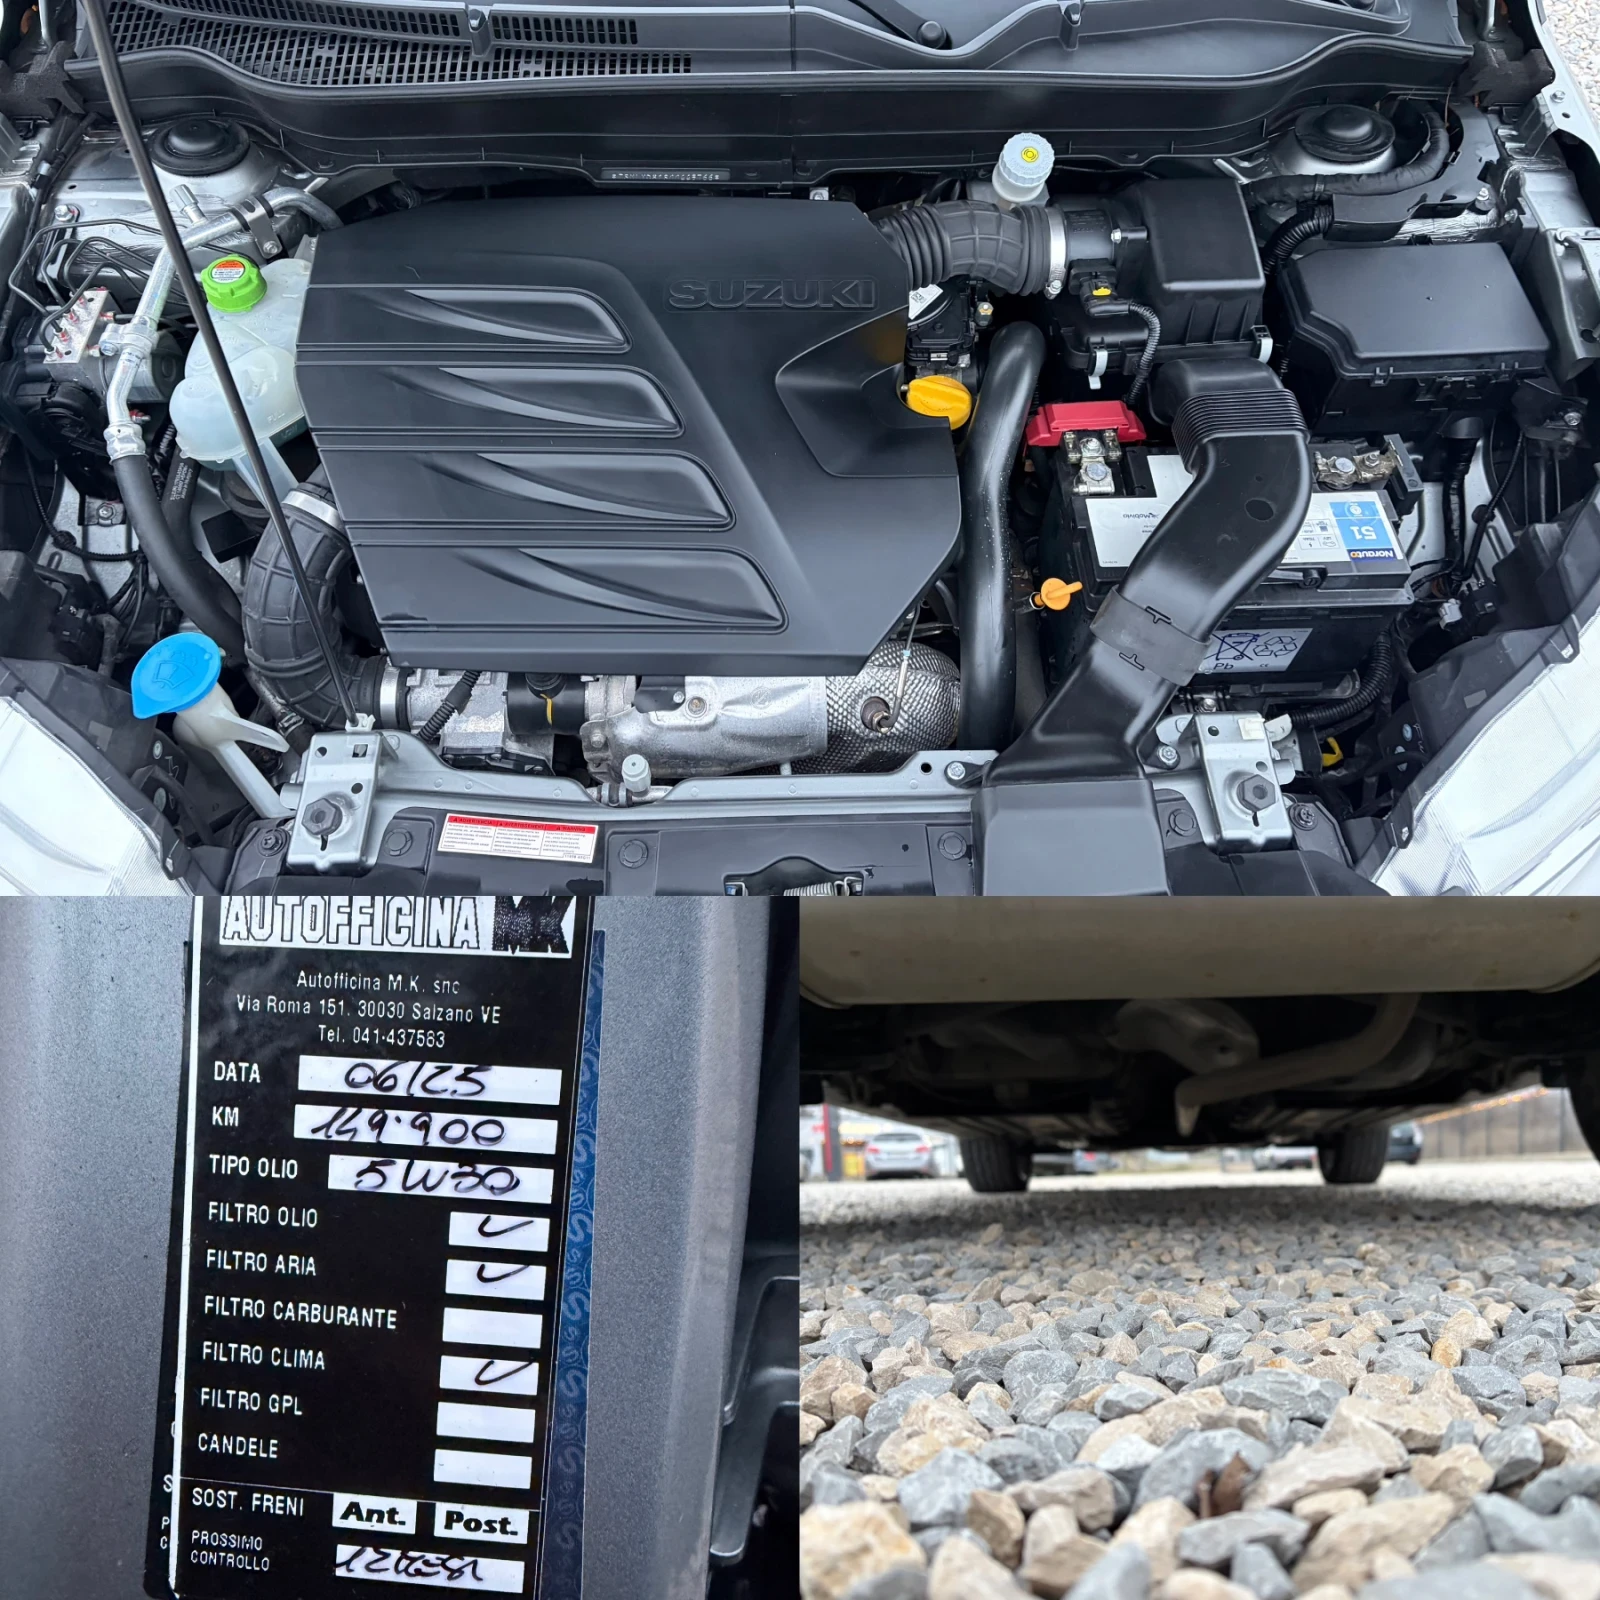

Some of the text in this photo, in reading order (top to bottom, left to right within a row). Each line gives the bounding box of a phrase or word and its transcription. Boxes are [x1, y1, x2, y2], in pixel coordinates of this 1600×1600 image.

[668, 278, 877, 310] SUZUKI
[1350, 525, 1377, 541] 51
[1350, 549, 1394, 559] Norauto
[1213, 662, 1234, 670] Pb
[221, 896, 481, 950] AUTOFFICINA
[297, 970, 461, 994] Autofficina M.K. snc
[236, 994, 261, 1012] Via
[266, 996, 311, 1015] Roma
[357, 1000, 405, 1019] 30030
[412, 1003, 475, 1024] Salzano
[481, 1006, 501, 1024] VE
[318, 1024, 346, 1044] Tel.
[213, 1061, 261, 1084] DATA
[211, 1106, 239, 1127] KM
[209, 1155, 299, 1179] TIPO OLIO
[208, 1203, 318, 1228] FILTRO OLIO
[206, 1249, 317, 1277] FILTRO ARIA
[204, 1296, 398, 1329] FILTRO CARBURANTE
[202, 1342, 326, 1371] FILTRO CLIMA
[200, 1388, 303, 1416] FILTRO GPL
[198, 1434, 280, 1459] CANDELE
[191, 1488, 305, 1517] SOST. FRENI
[340, 1500, 407, 1527] Ant.
[444, 1511, 519, 1537] Post.
[190, 1529, 264, 1551] PROSSIMO
[190, 1550, 271, 1572] CONTROLLO
